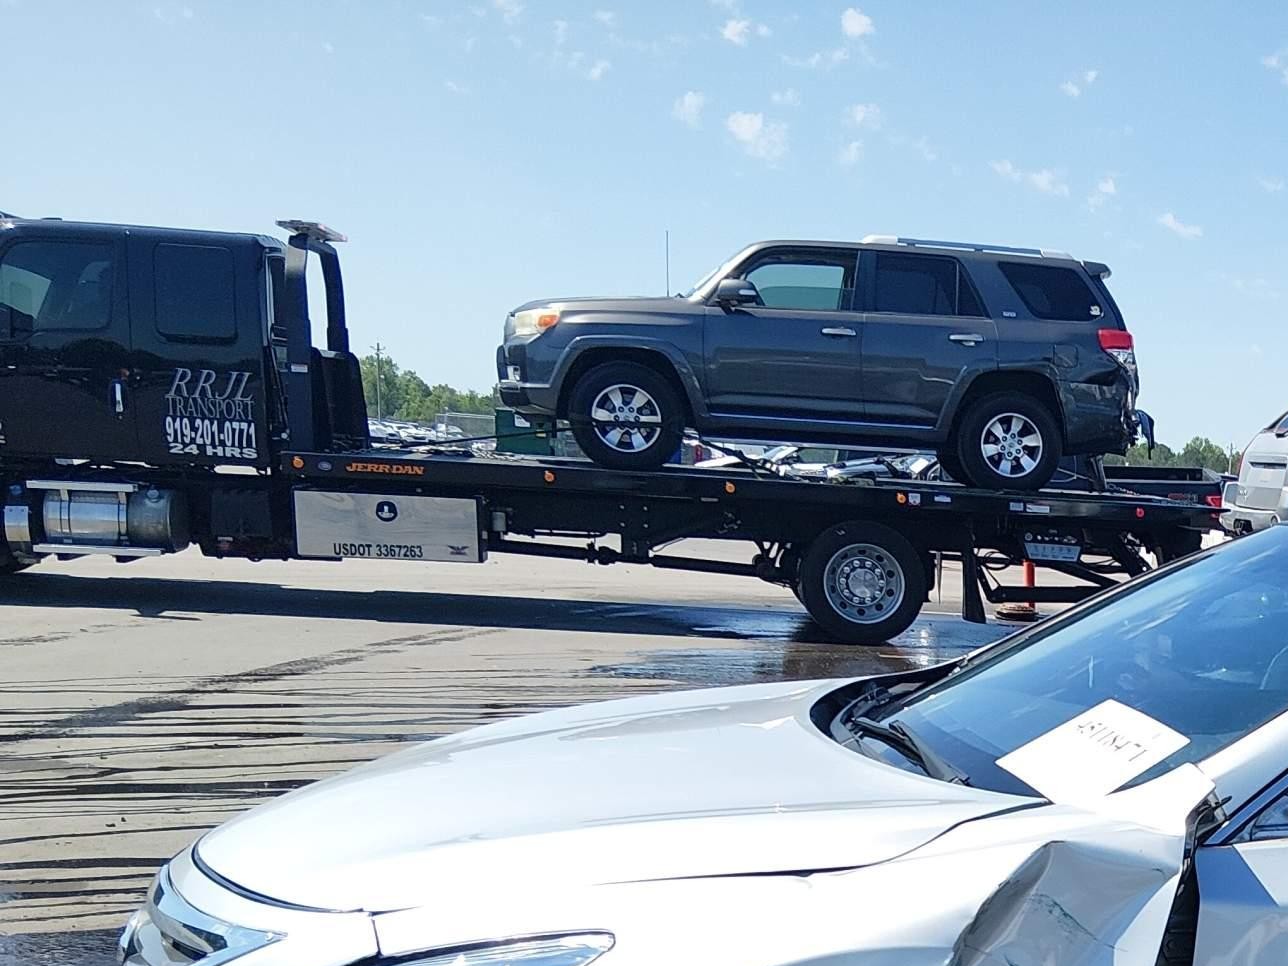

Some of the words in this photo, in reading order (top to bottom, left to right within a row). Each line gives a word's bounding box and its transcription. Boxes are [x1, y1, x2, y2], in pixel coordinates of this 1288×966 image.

[165, 395, 255, 420] TRANSPORT
[165, 416, 256, 448] 919-201-0771
[169, 443, 200, 455] 24
[206, 445, 258, 459] HRS
[333, 543, 372, 557] USDOT
[376, 544, 424, 558] 3367263
